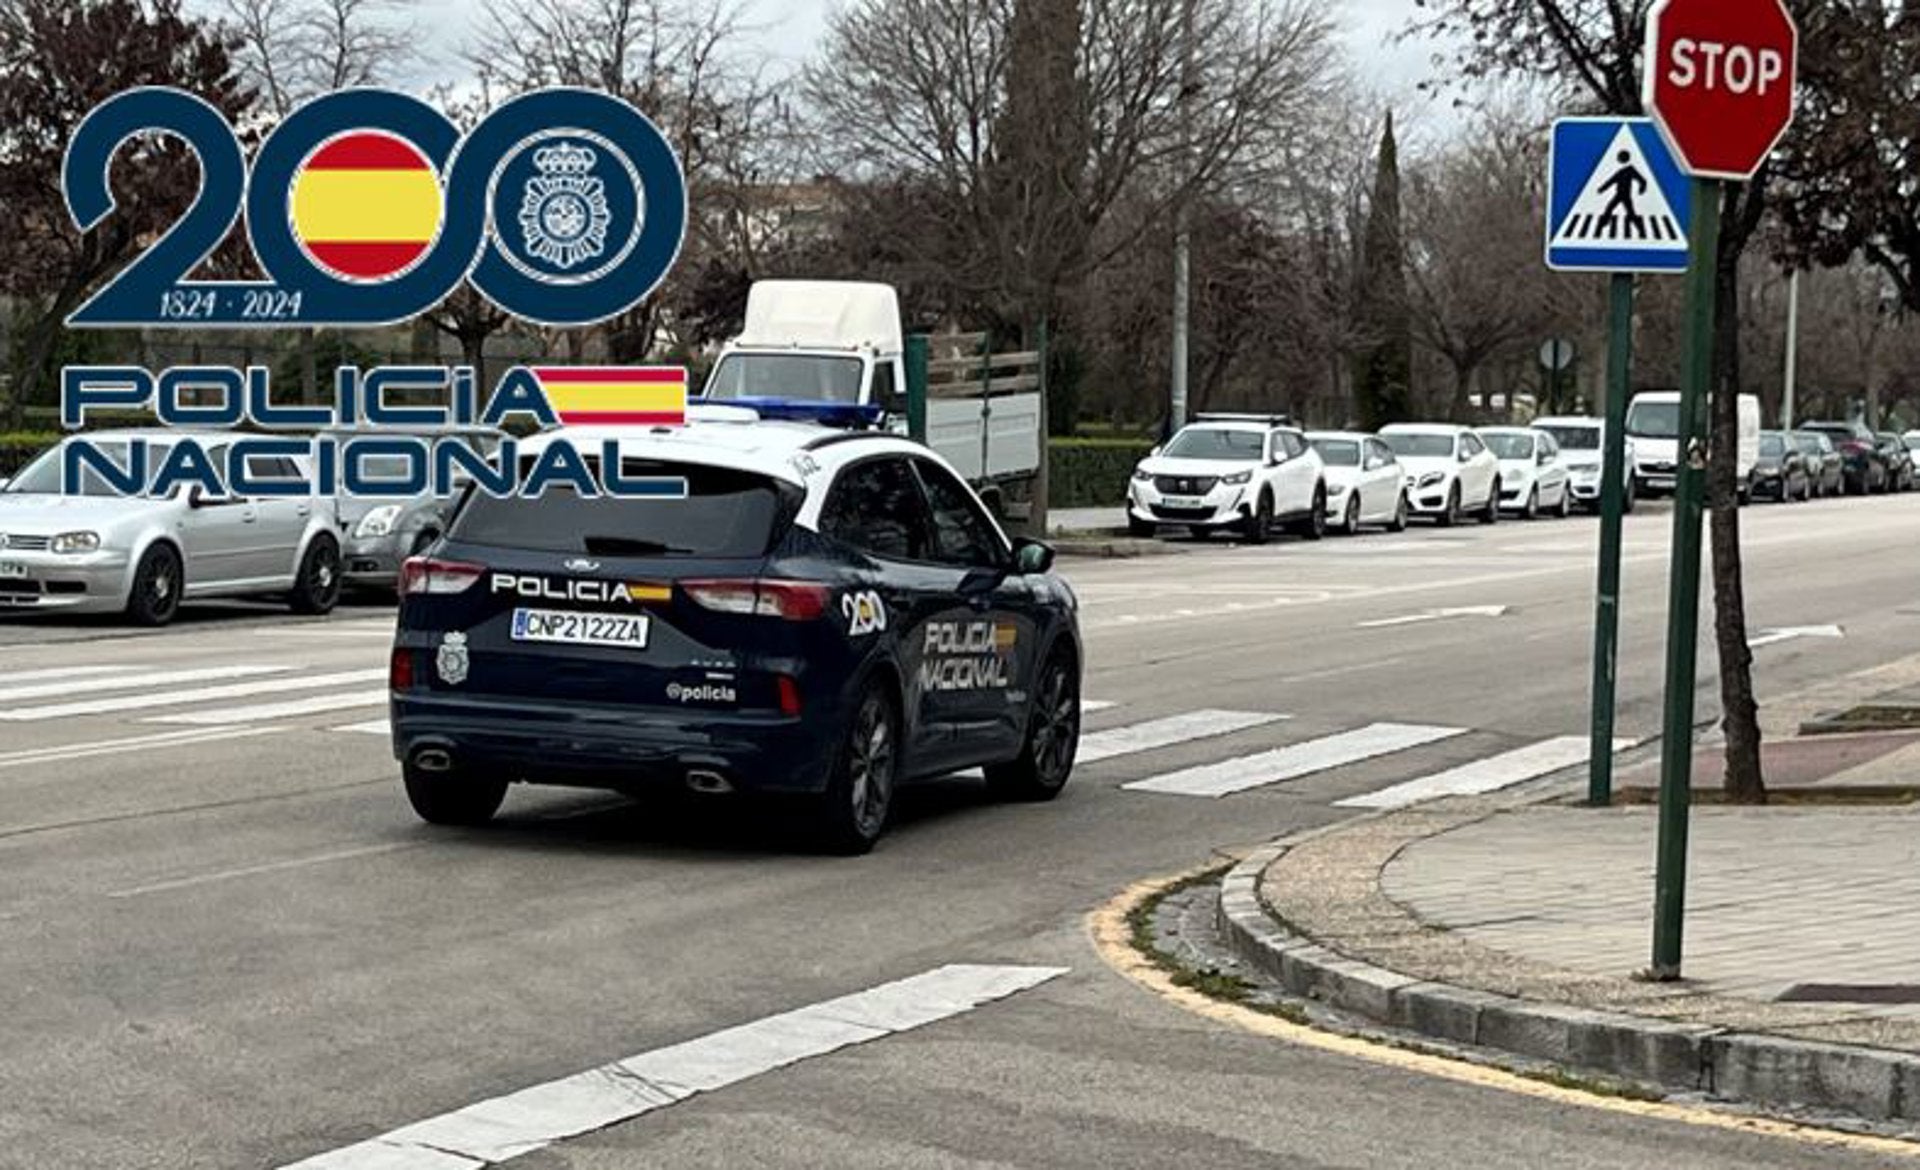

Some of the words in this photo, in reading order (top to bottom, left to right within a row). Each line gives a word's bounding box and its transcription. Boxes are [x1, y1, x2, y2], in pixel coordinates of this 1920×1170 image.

[1668, 38, 1782, 96] STOP
[491, 573, 633, 604] POLICIA
[527, 612, 641, 642] CNP2122ZA
[842, 590, 887, 636] 200
[918, 656, 1007, 690] NACIONAL
